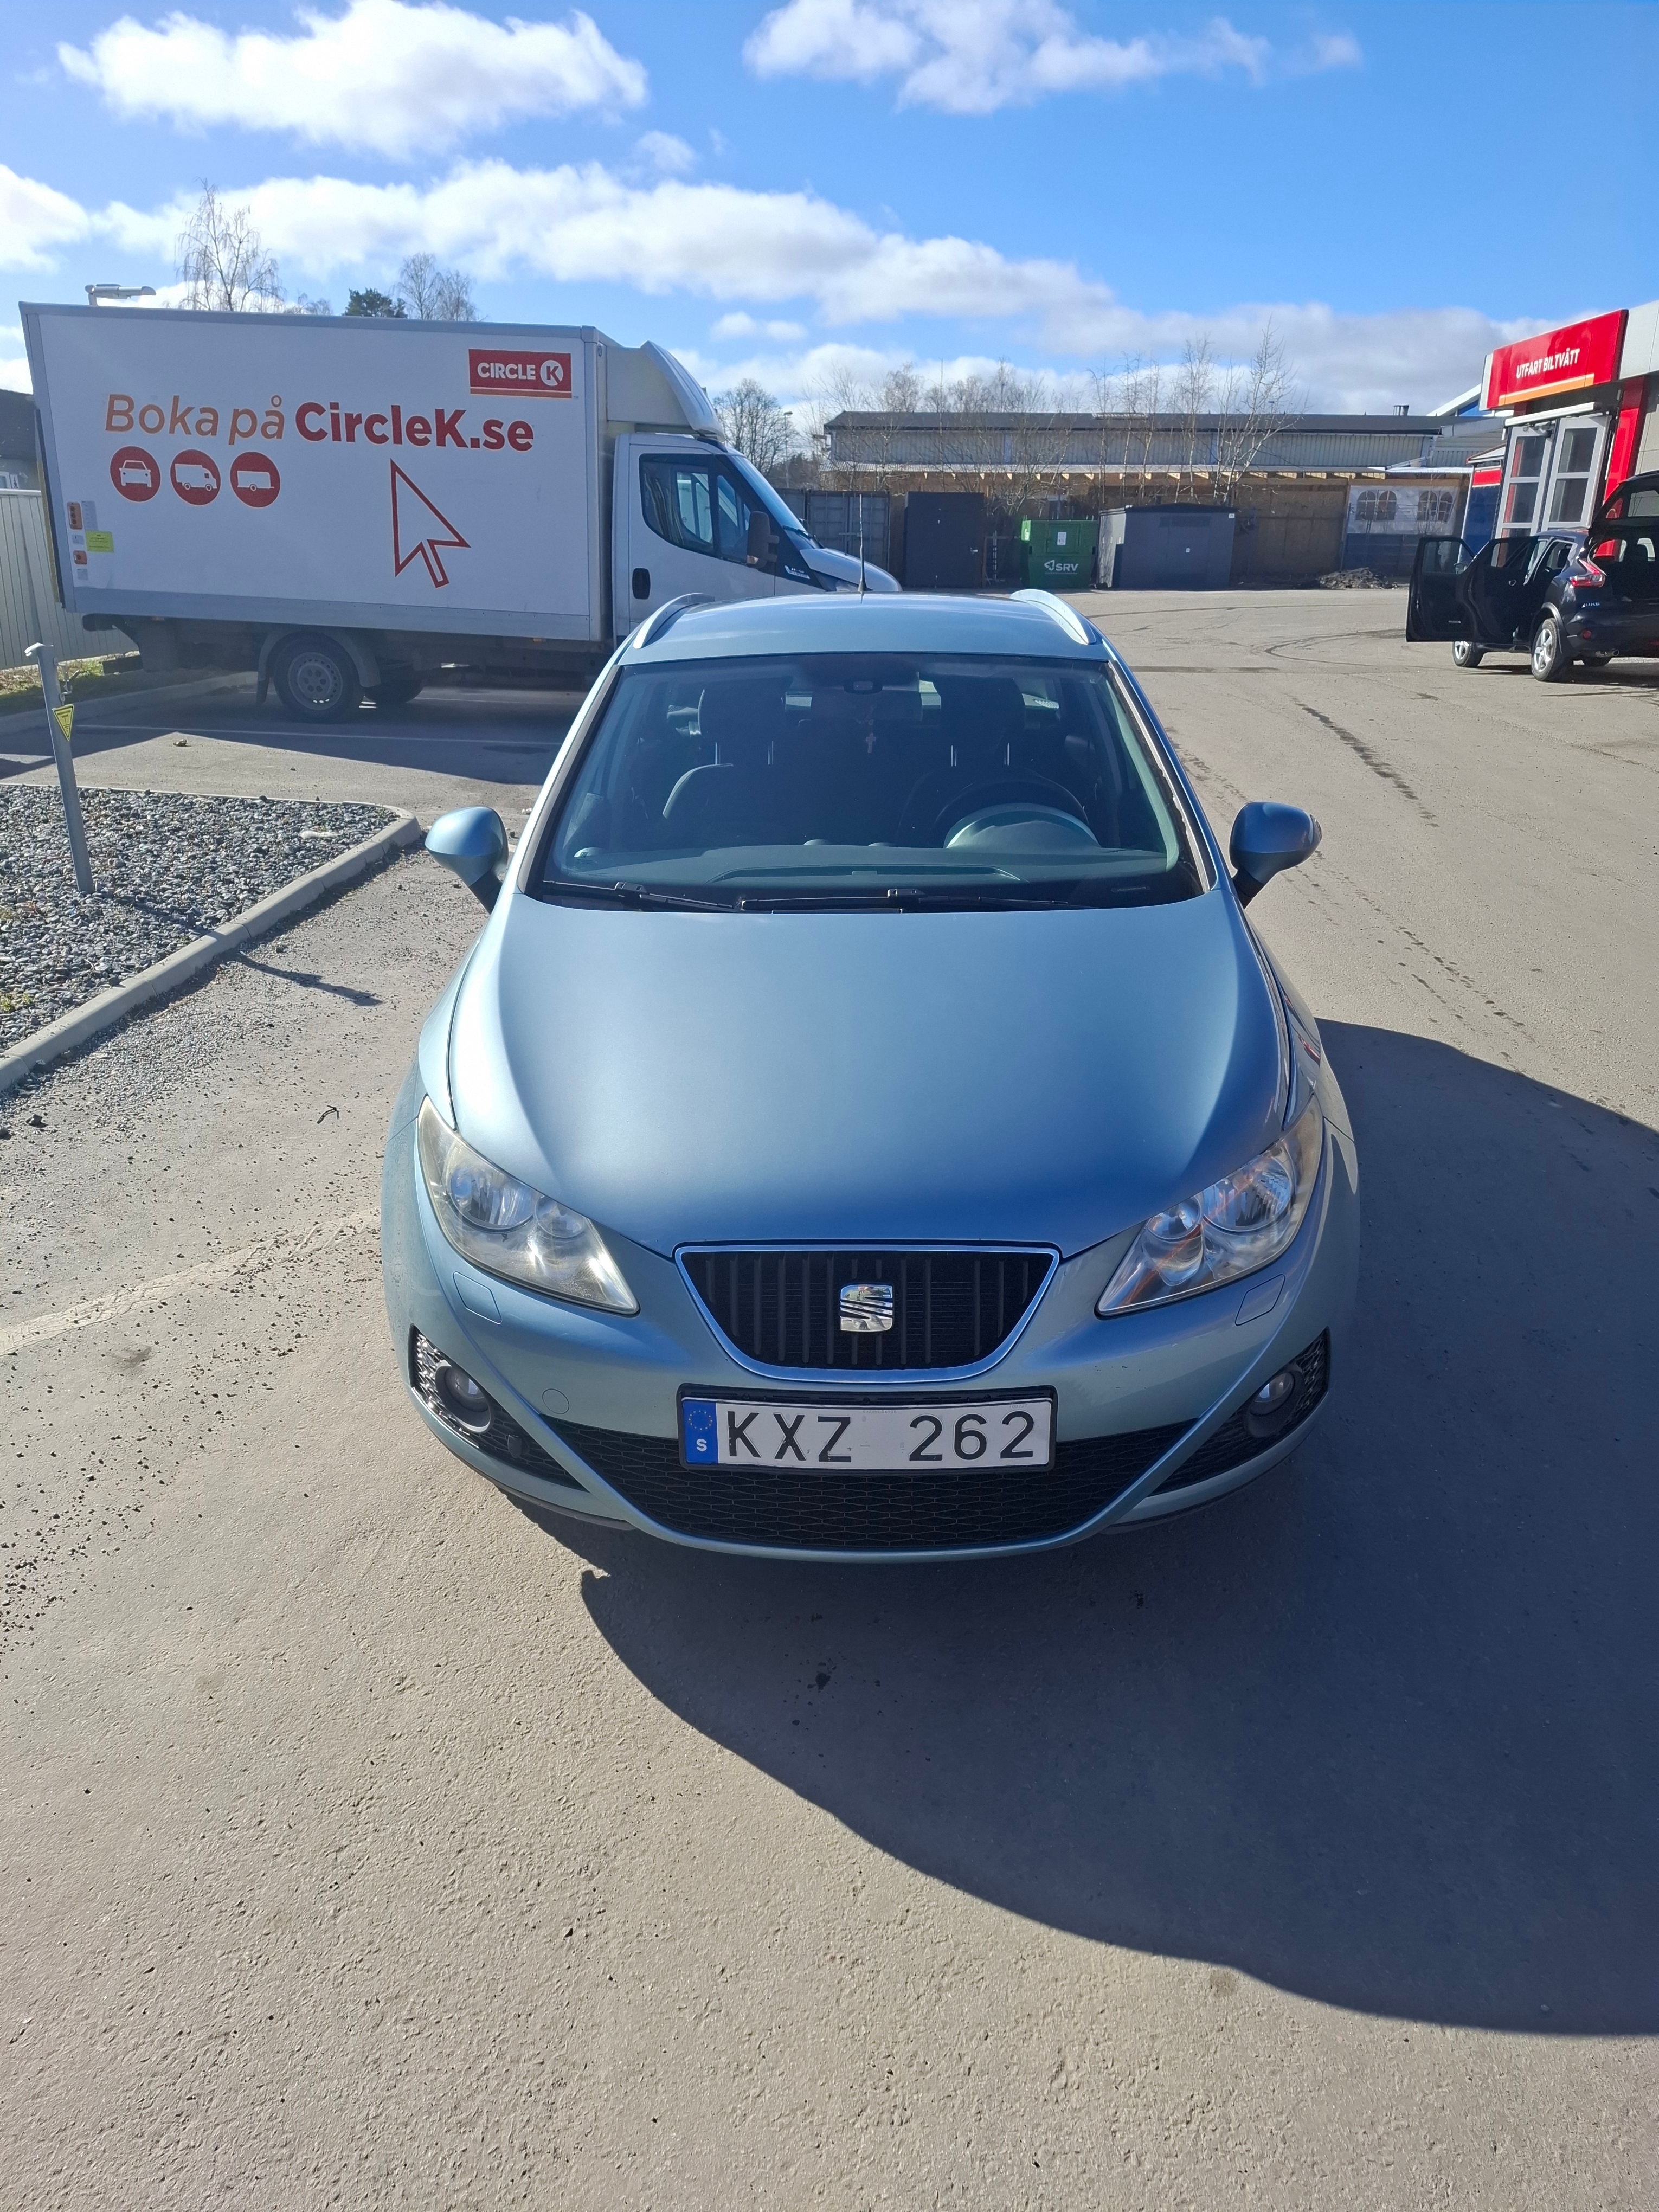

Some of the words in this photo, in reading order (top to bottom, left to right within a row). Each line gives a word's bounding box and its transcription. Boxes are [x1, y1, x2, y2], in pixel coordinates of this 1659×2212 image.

[477, 362, 536, 380] CIRCLE
[544, 363, 562, 384] K
[1516, 358, 1544, 378] UTFART
[1542, 347, 1580, 372] BILTVÄTT
[105, 394, 220, 436] Boka
[228, 395, 285, 445] på
[295, 401, 535, 452] CircleK.se
[1055, 563, 1079, 571] SRV
[696, 1438, 708, 1451] S
[727, 1411, 852, 1463] KXZ
[909, 1411, 1034, 1462] 262
